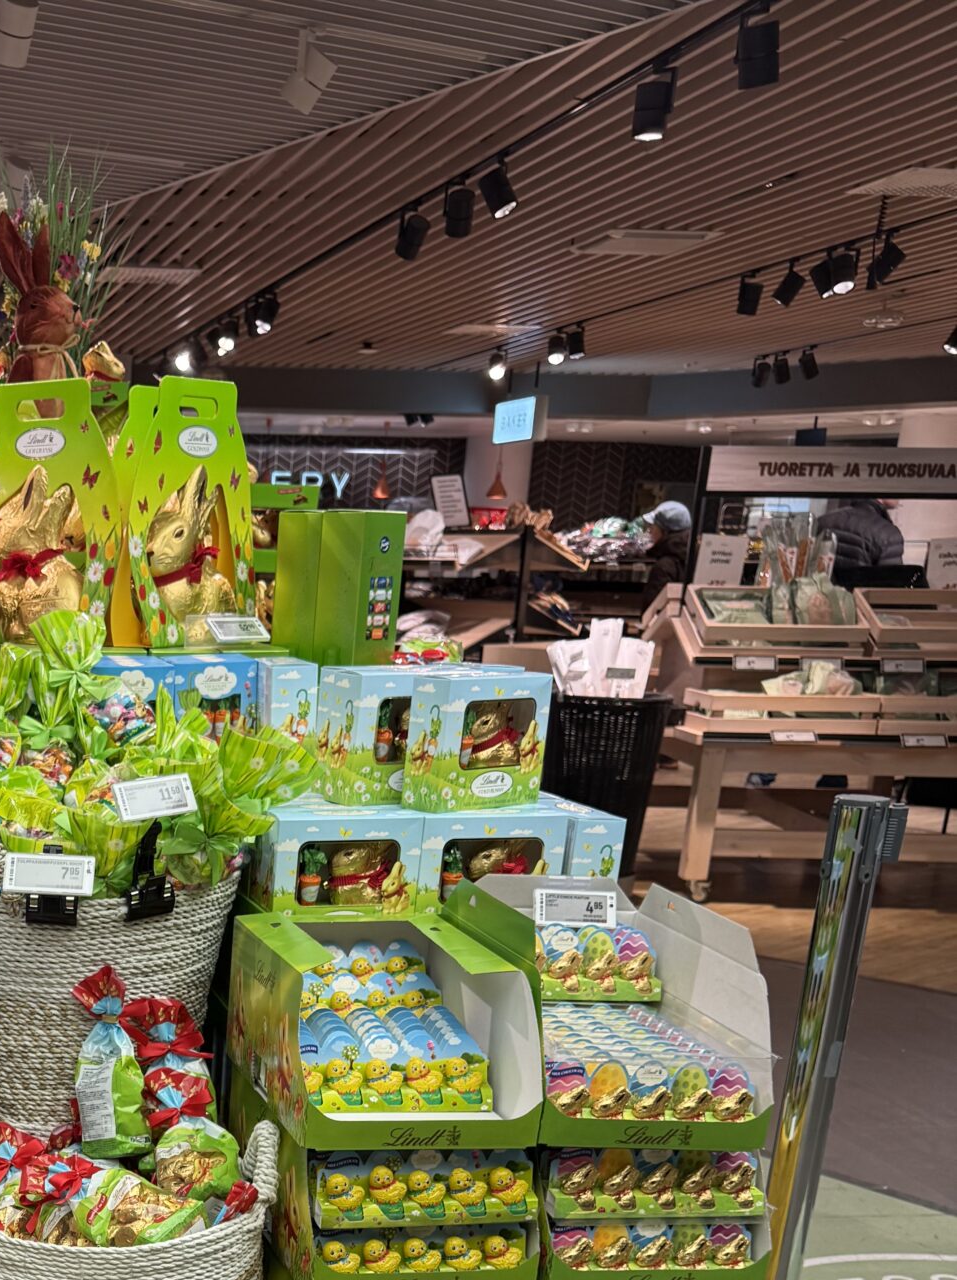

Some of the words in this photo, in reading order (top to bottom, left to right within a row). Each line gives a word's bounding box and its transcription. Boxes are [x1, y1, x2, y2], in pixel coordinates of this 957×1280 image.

[759, 462, 834, 477] TUORETTA
[843, 463, 861, 477] JA
[867, 463, 957, 478] TUOKSUVAA
[480, 773, 500, 786] Lindt
[382, 1127, 445, 1147] Lindt
[615, 1126, 679, 1145] Lindt
